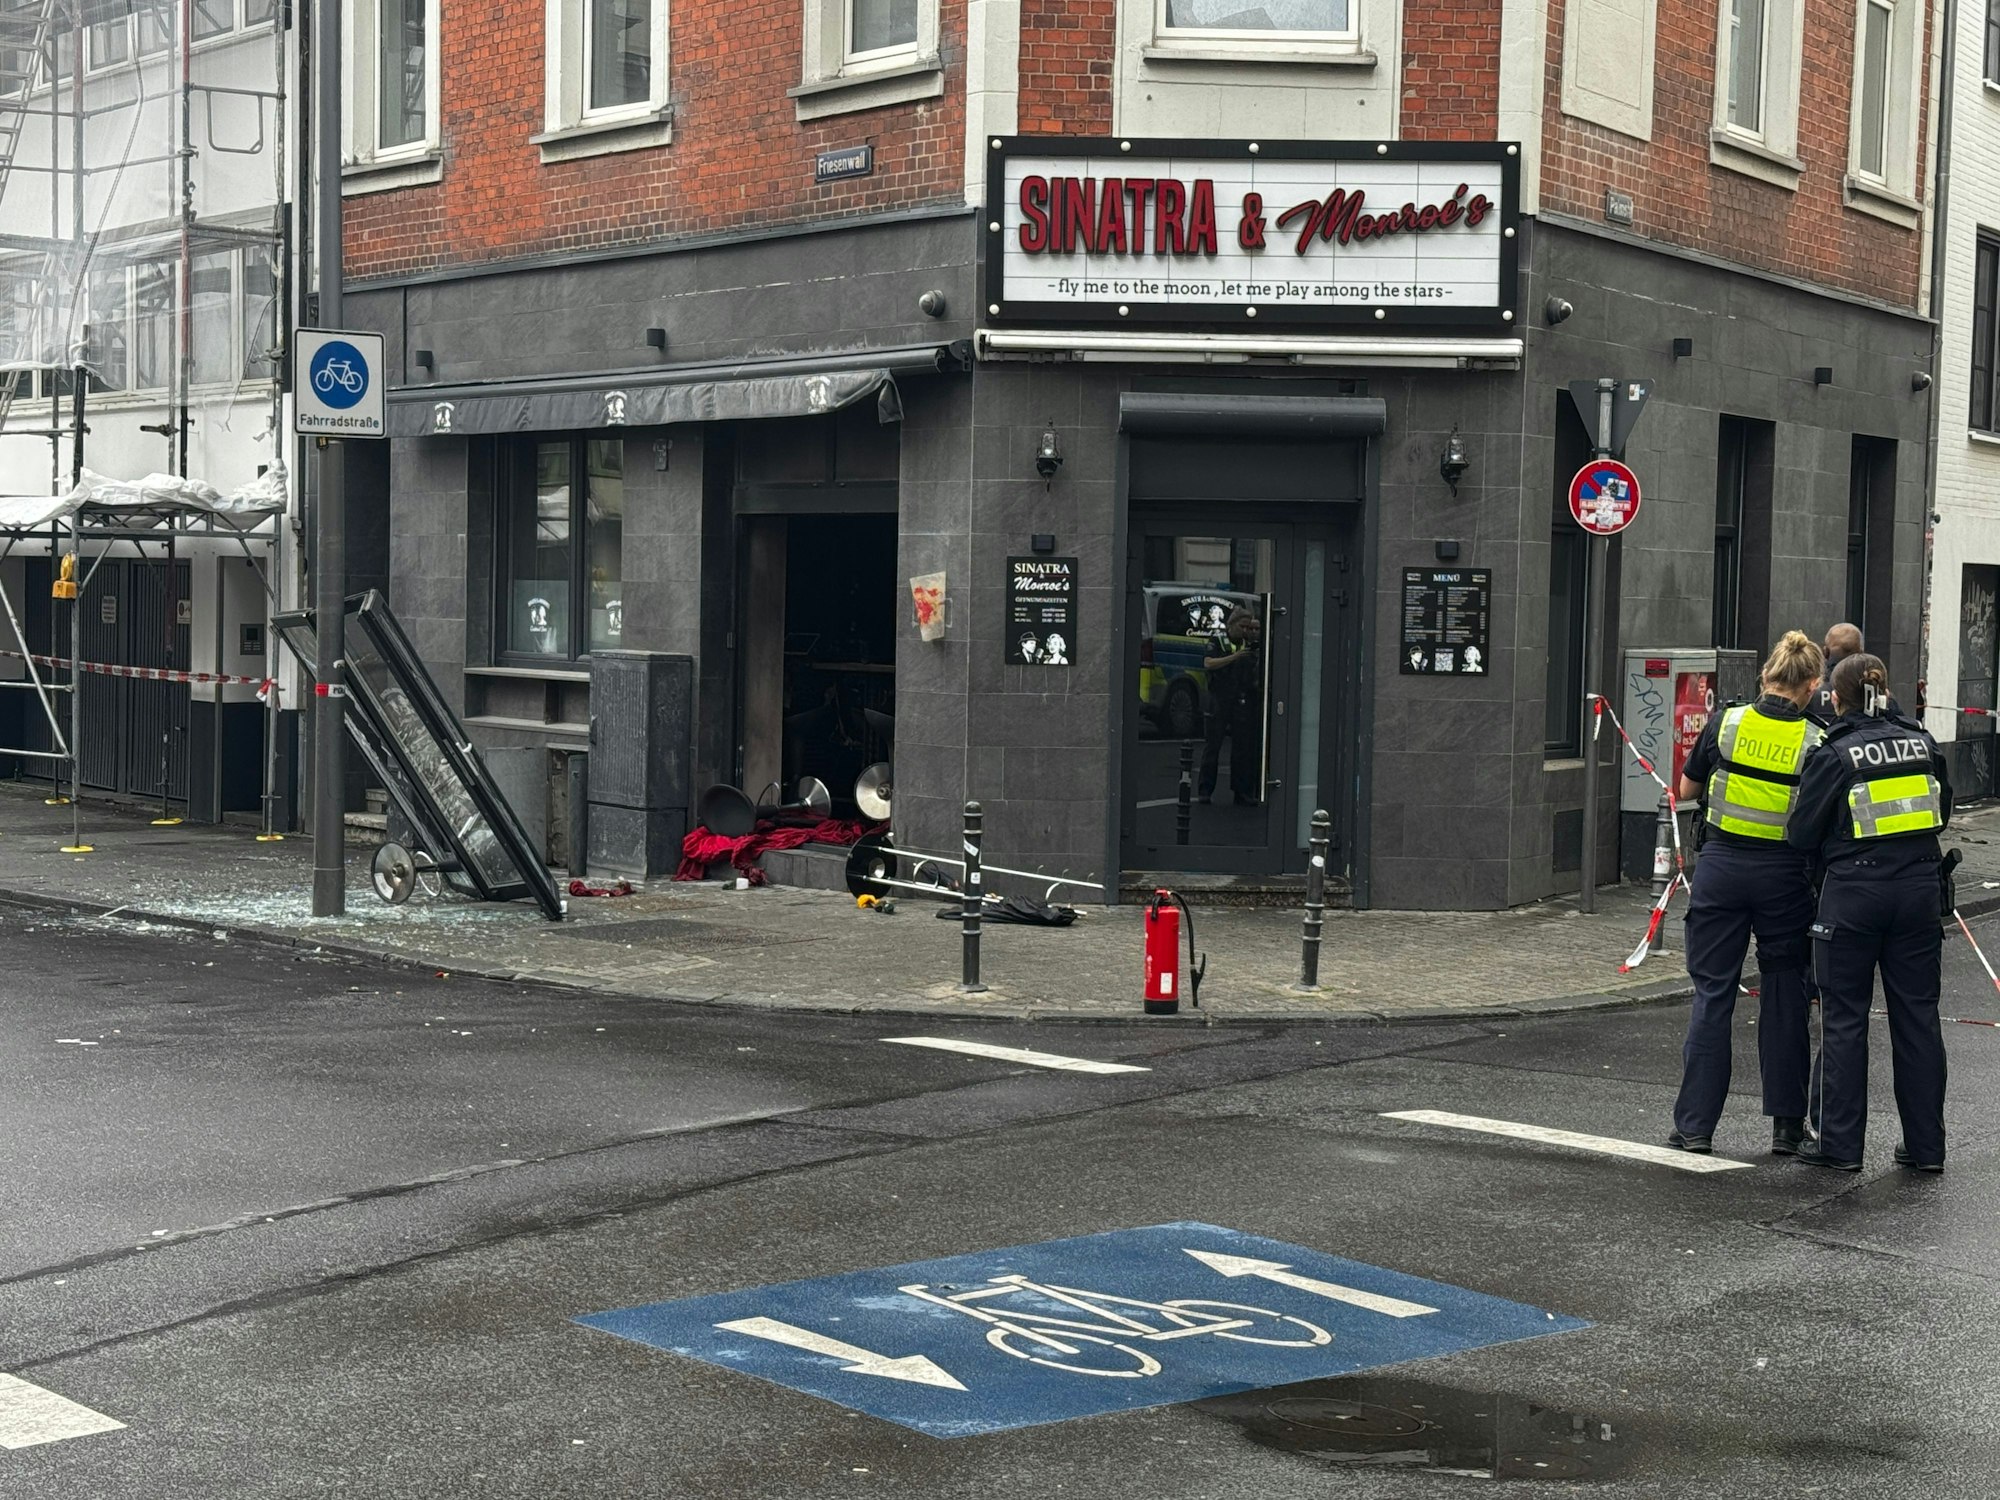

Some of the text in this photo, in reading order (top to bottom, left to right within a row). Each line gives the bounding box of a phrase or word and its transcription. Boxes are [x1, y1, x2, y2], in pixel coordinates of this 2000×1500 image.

[818, 151, 865, 175] Friesenwall
[1019, 175, 1218, 254] SINATRA
[1239, 192, 1267, 249] &
[1083, 282, 1109, 294] me
[1114, 281, 1129, 294] to
[1133, 279, 1159, 295] the
[1246, 284, 1271, 296] me
[1275, 281, 1309, 299] play
[1313, 285, 1369, 300] among
[1374, 282, 1399, 297] the
[300, 413, 380, 429] Fahrradstraße
[1014, 563, 1070, 574] SINATRA
[1737, 736, 1797, 766] POLIZEI
[1849, 738, 1929, 769] POLIZEI
